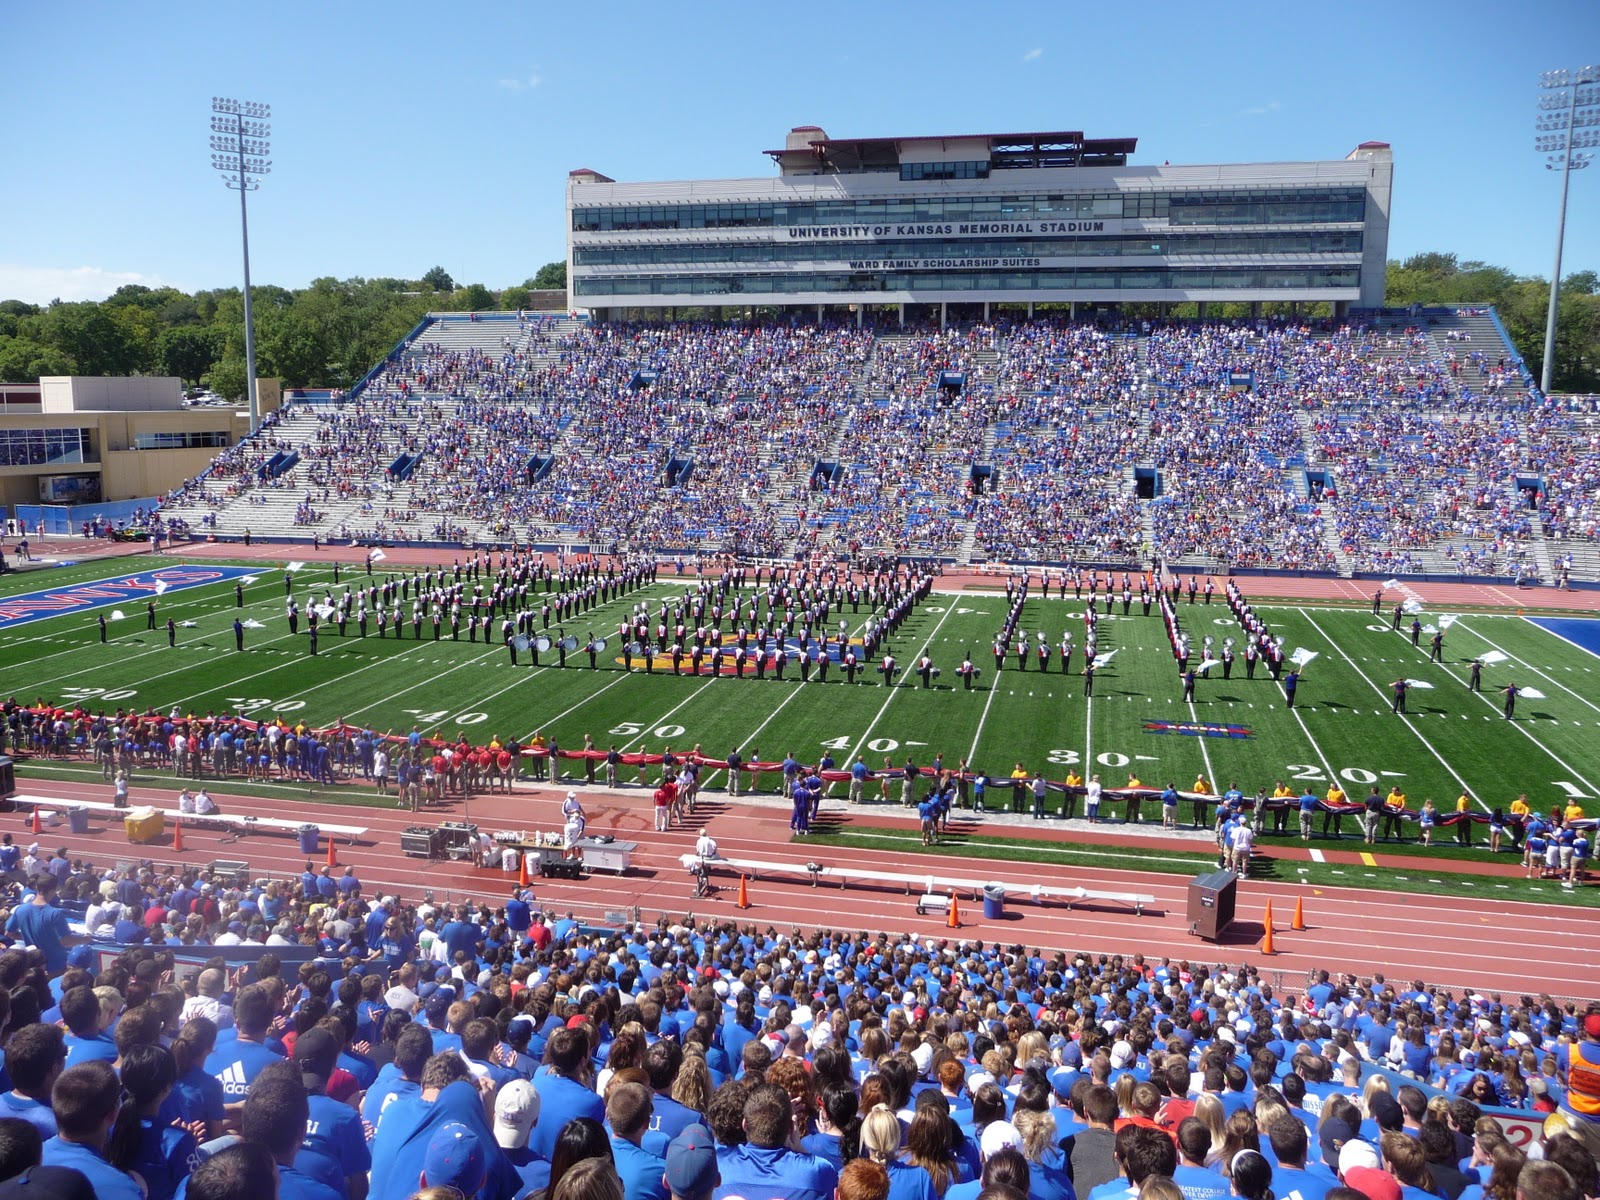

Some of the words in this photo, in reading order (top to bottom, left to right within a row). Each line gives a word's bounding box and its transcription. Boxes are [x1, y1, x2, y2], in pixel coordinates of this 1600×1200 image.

[789, 226, 870, 238] UNIVERSITY
[874, 226, 892, 235] OF
[896, 225, 953, 236] KANSAS
[959, 223, 1033, 234] MEMORIAL
[1040, 222, 1104, 233] STADIUM
[849, 260, 879, 269] WARD
[882, 260, 920, 269] FAMILY
[923, 259, 999, 268] SCHOLARSHIP
[1002, 258, 1040, 267] SUITES
[231, 698, 306, 712] 30
[415, 709, 488, 725] 40
[608, 722, 686, 738] 50
[820, 735, 899, 751] 40
[1046, 749, 1130, 767] 30
[1286, 764, 1378, 784] 20
